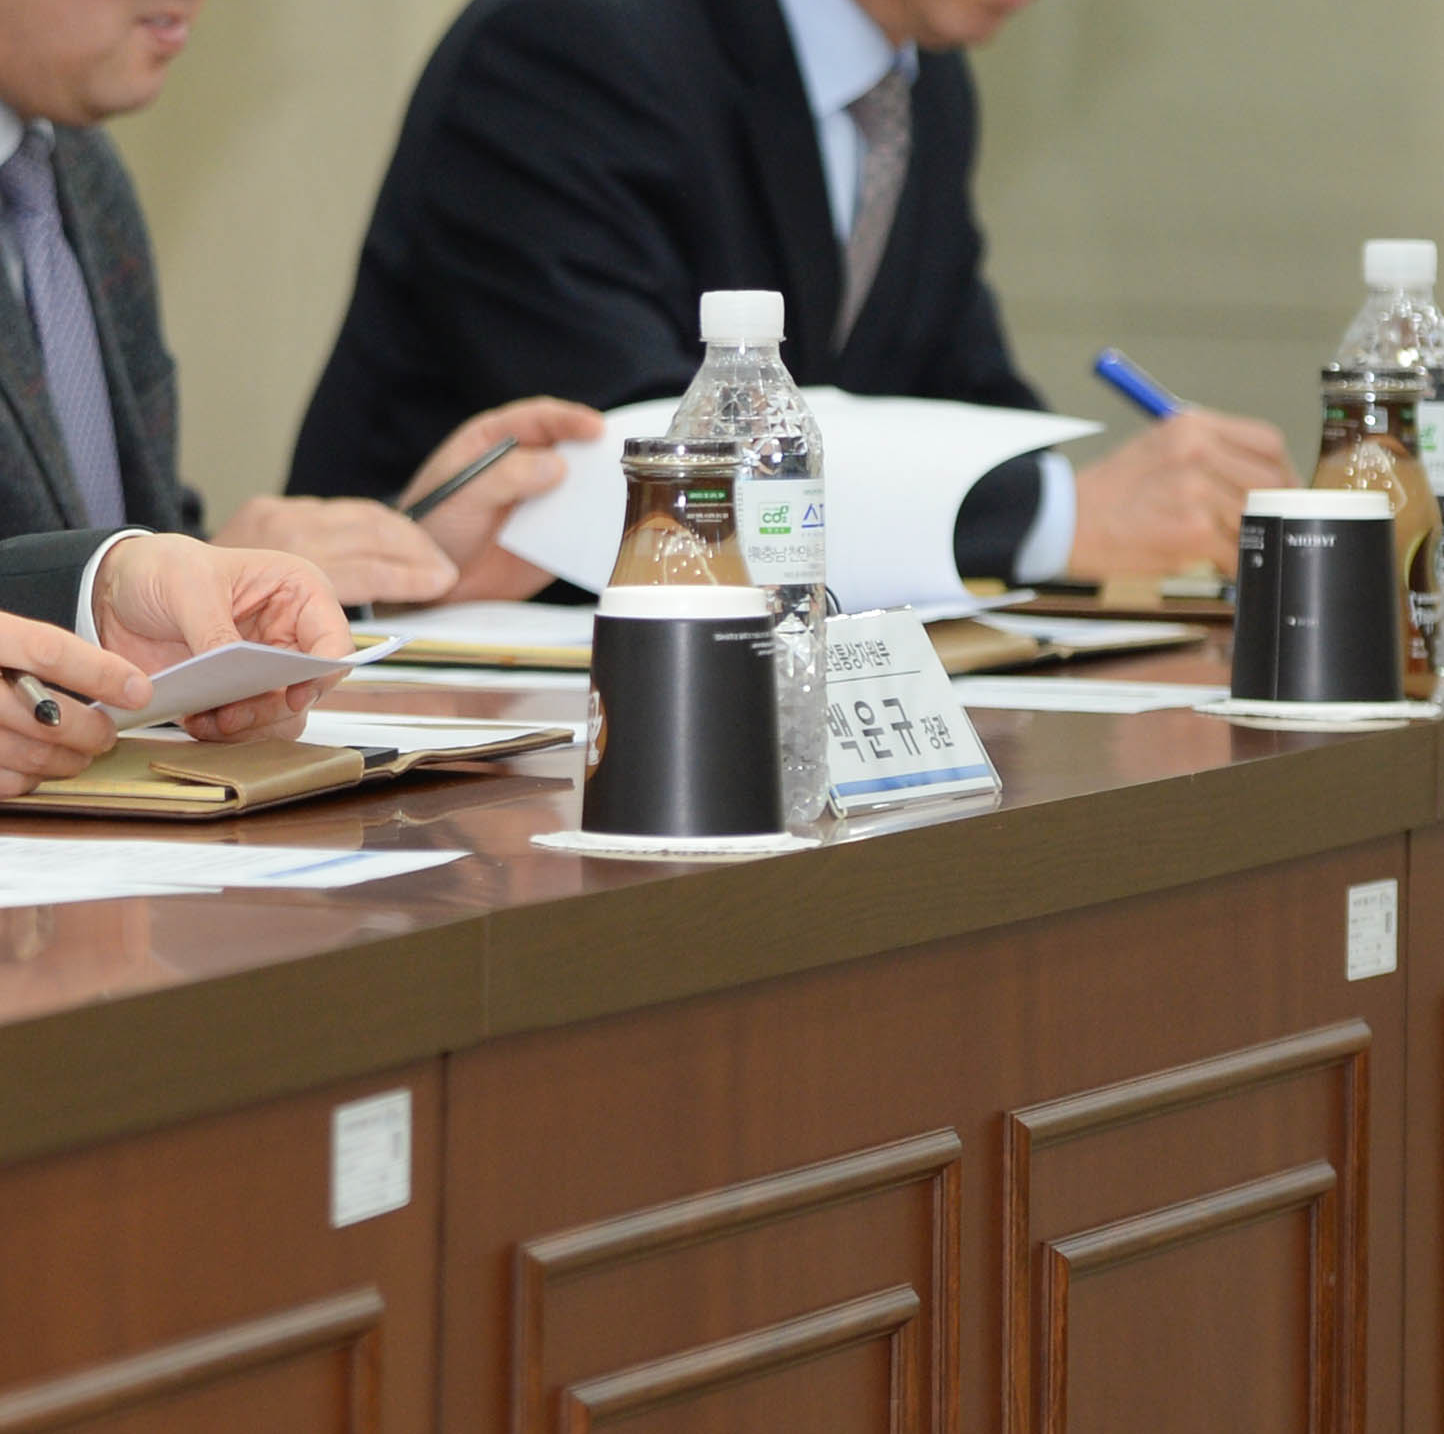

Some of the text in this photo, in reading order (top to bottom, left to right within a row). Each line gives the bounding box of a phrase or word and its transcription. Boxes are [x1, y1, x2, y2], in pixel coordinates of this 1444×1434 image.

[826, 639, 892, 672] 업통상자원부
[827, 697, 955, 763] 백운규 장관
